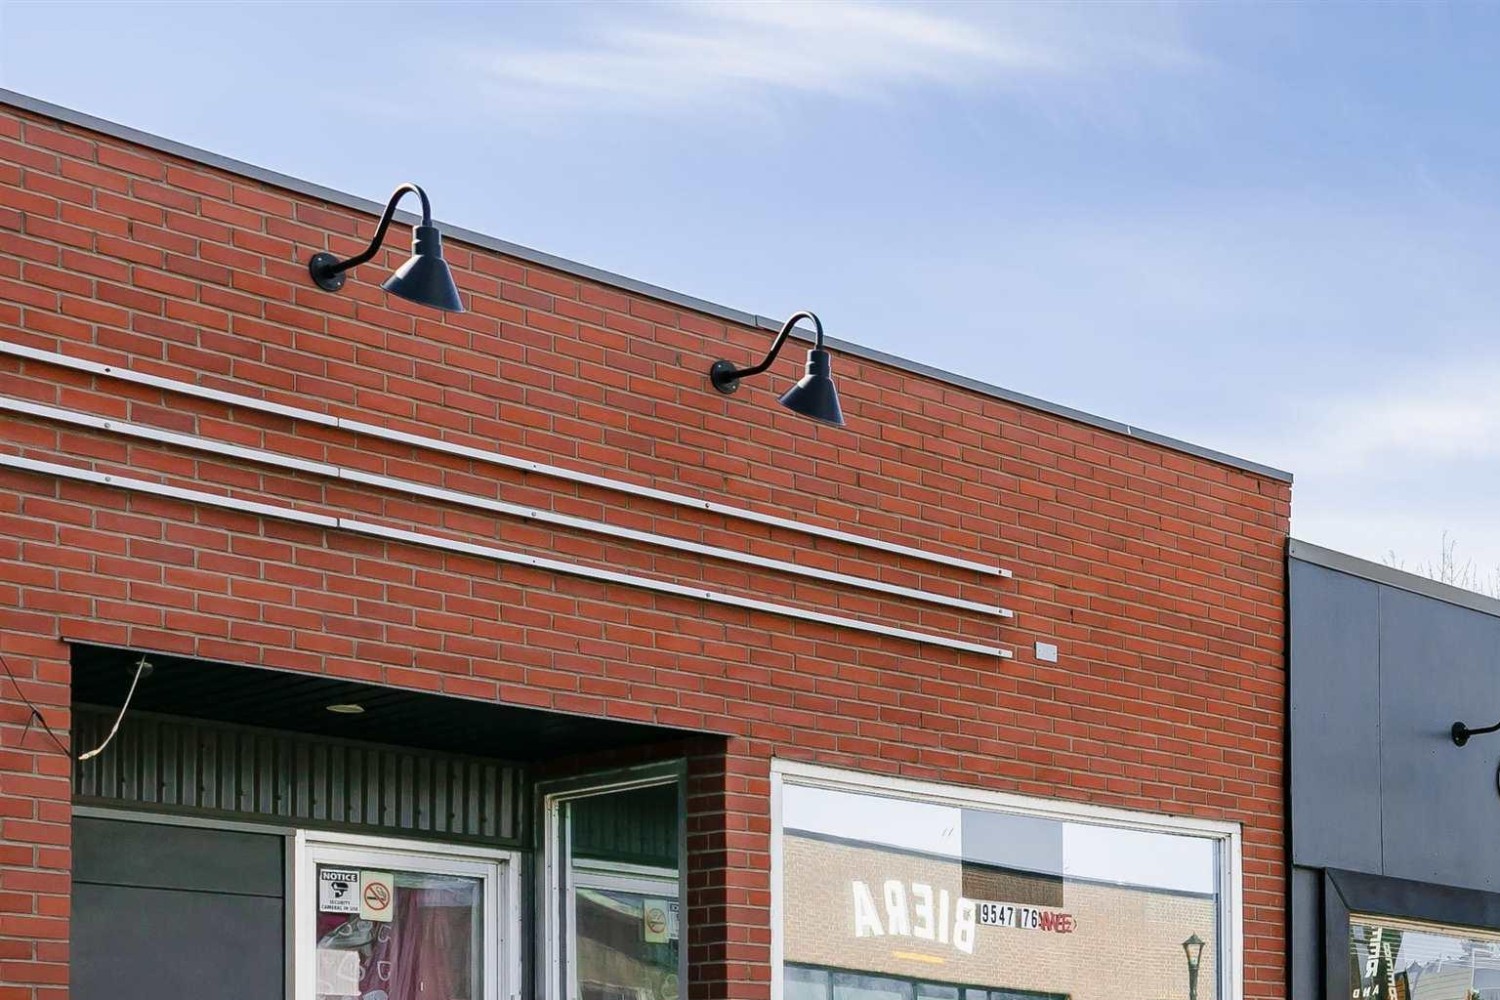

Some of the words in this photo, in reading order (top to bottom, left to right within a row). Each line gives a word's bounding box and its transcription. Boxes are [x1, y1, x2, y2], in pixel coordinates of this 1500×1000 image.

[322, 872, 357, 882] NOTICE
[982, 903, 1014, 926] 9547
[1022, 908, 1038, 928] 76
